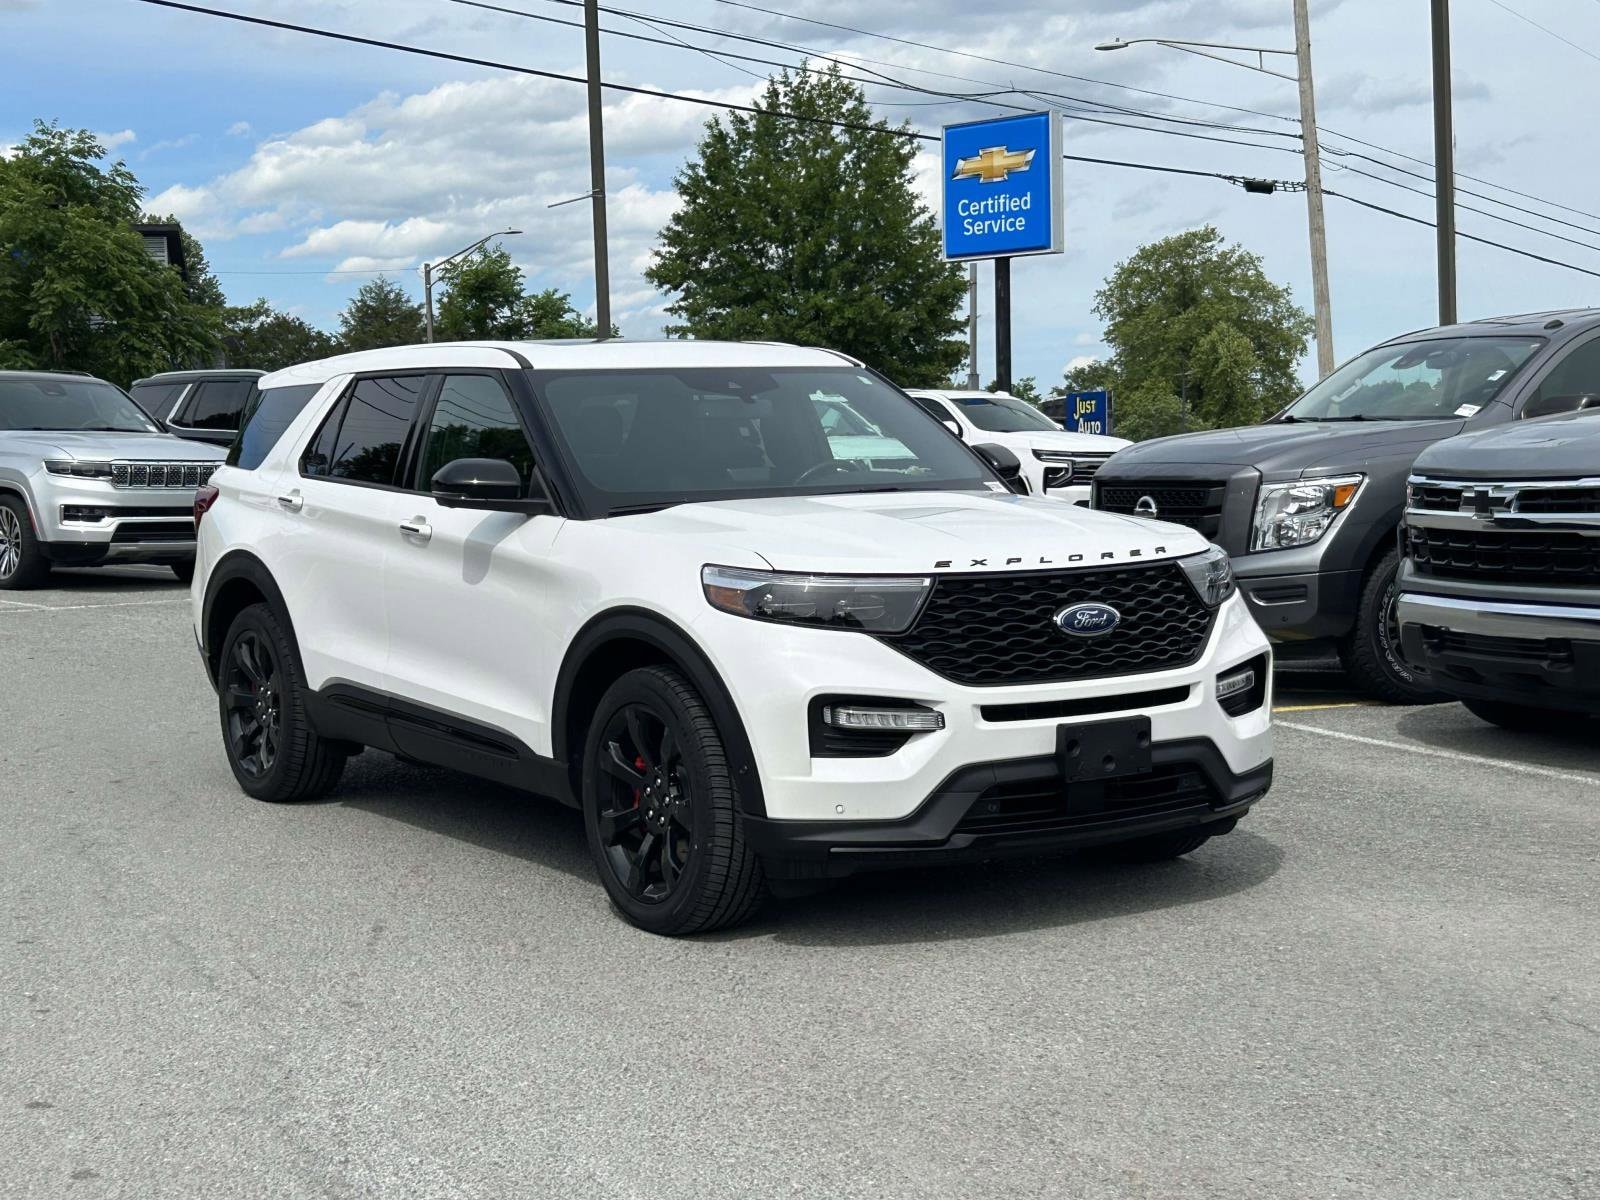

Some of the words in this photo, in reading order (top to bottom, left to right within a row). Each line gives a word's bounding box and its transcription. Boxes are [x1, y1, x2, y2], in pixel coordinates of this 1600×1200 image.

[958, 191, 1031, 217] Certified
[963, 215, 1025, 236] Service
[1073, 397, 1096, 420] JUST
[1077, 417, 1101, 434] AUTO
[934, 546, 1167, 569] EXPLORER
[1074, 610, 1108, 628] Ford
